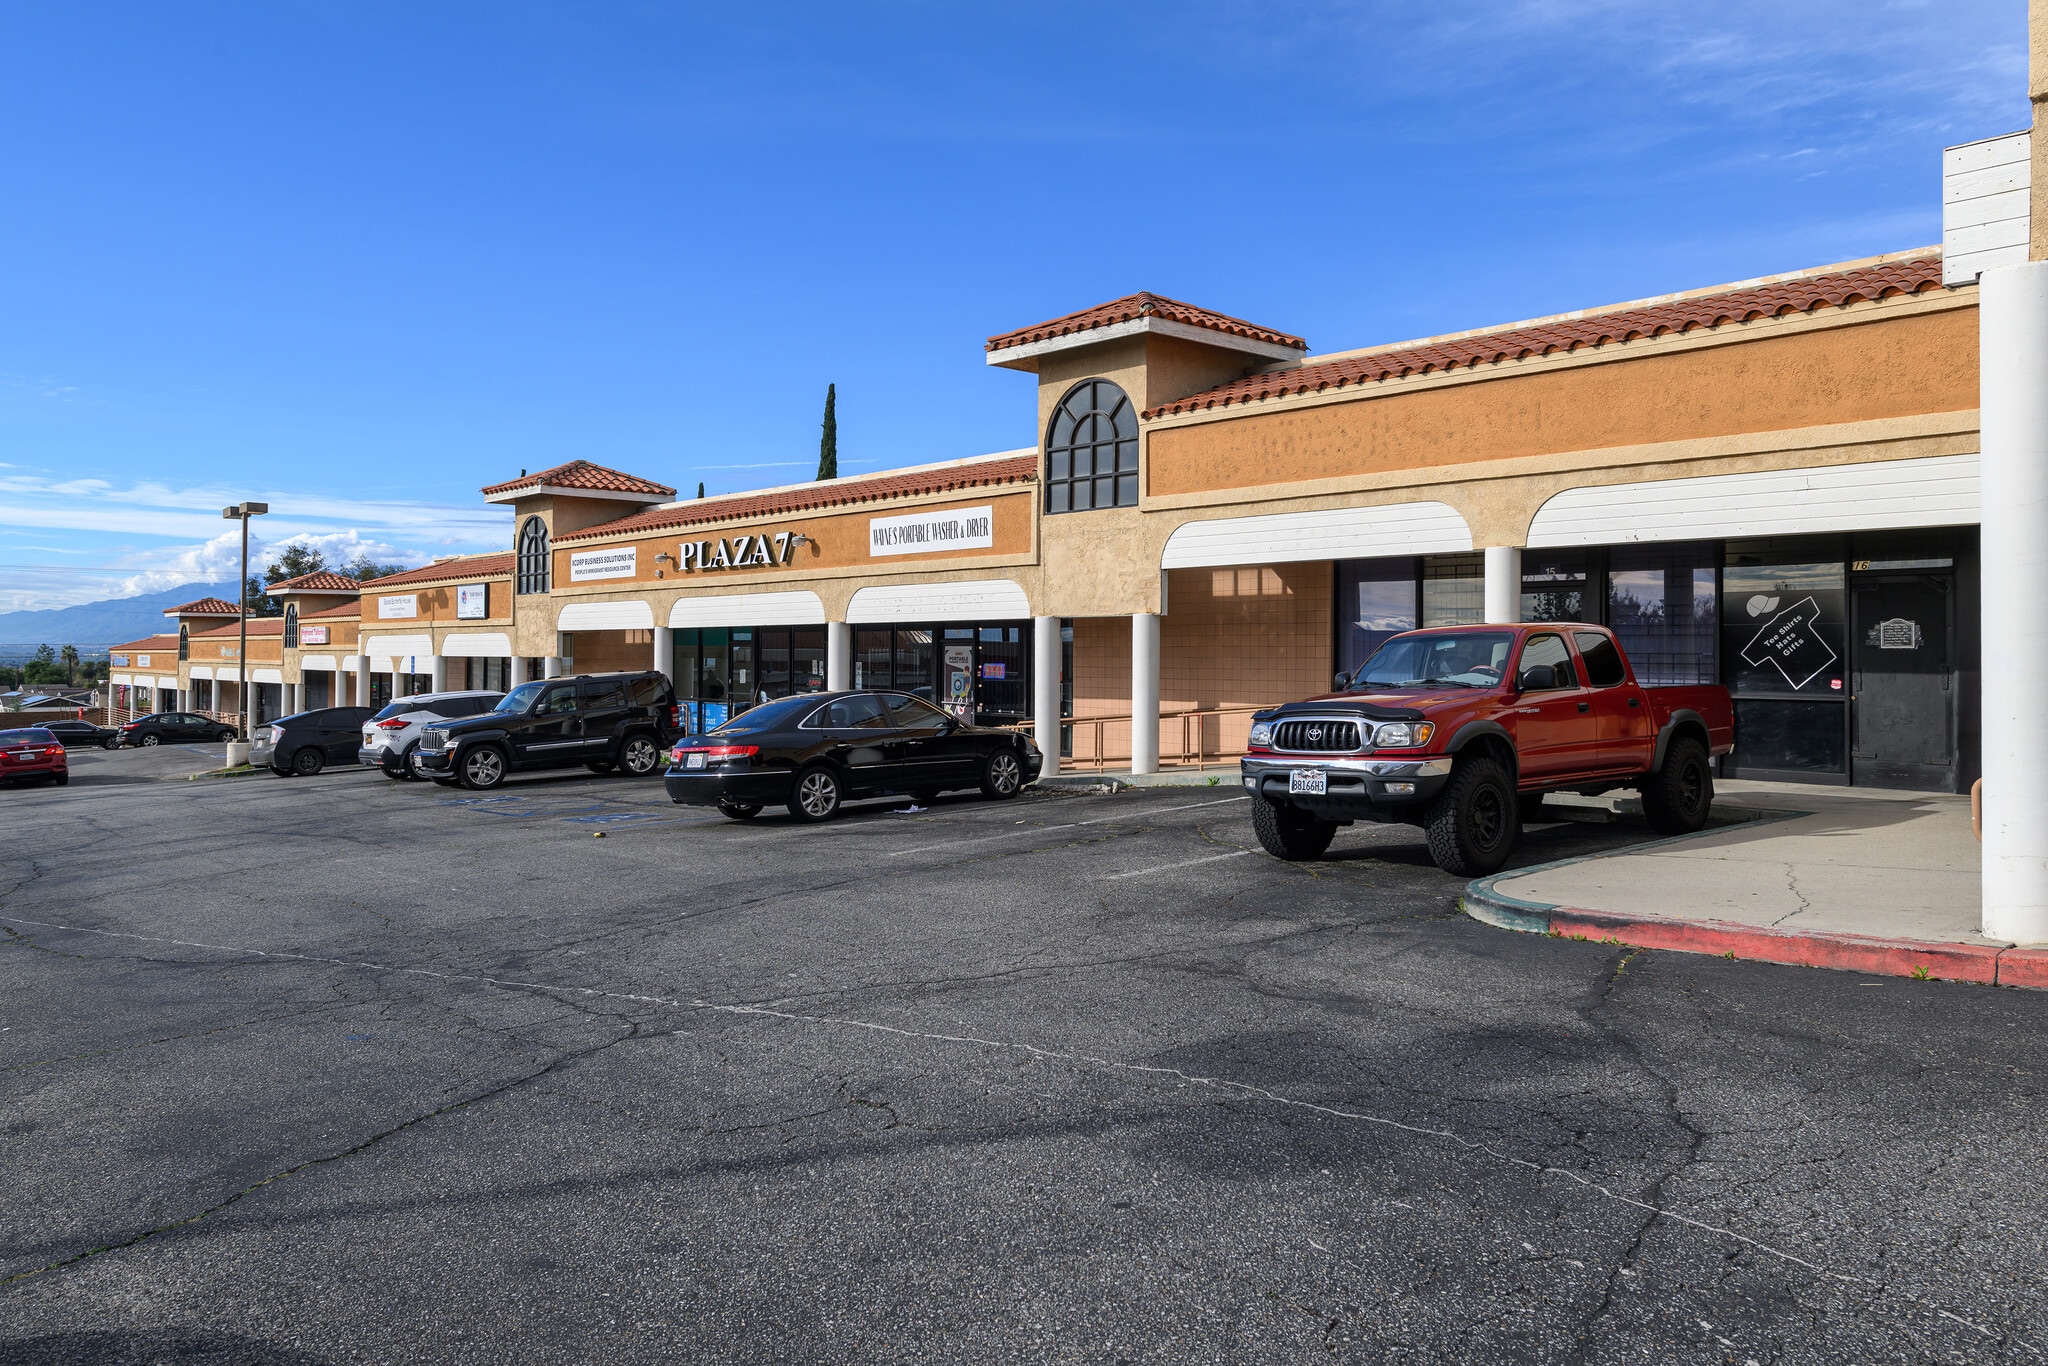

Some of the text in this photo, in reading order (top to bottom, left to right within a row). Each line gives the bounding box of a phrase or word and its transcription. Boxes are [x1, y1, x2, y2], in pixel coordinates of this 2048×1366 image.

[898, 523, 930, 545] PORTABLE
[931, 520, 959, 541] WASHER
[960, 525, 965, 539] &
[966, 517, 989, 538] DRYER
[585, 557, 604, 565] BUSINESS
[604, 554, 626, 563] SOLUTIONS
[627, 553, 635, 561] INC
[678, 531, 793, 571] PLAZA 7
[1545, 567, 1556, 577] 15
[1855, 561, 1869, 570] 16
[1763, 614, 1803, 647] Tee Shirts
[1775, 632, 1797, 650] Hats
[1782, 638, 1805, 656] Gifts
